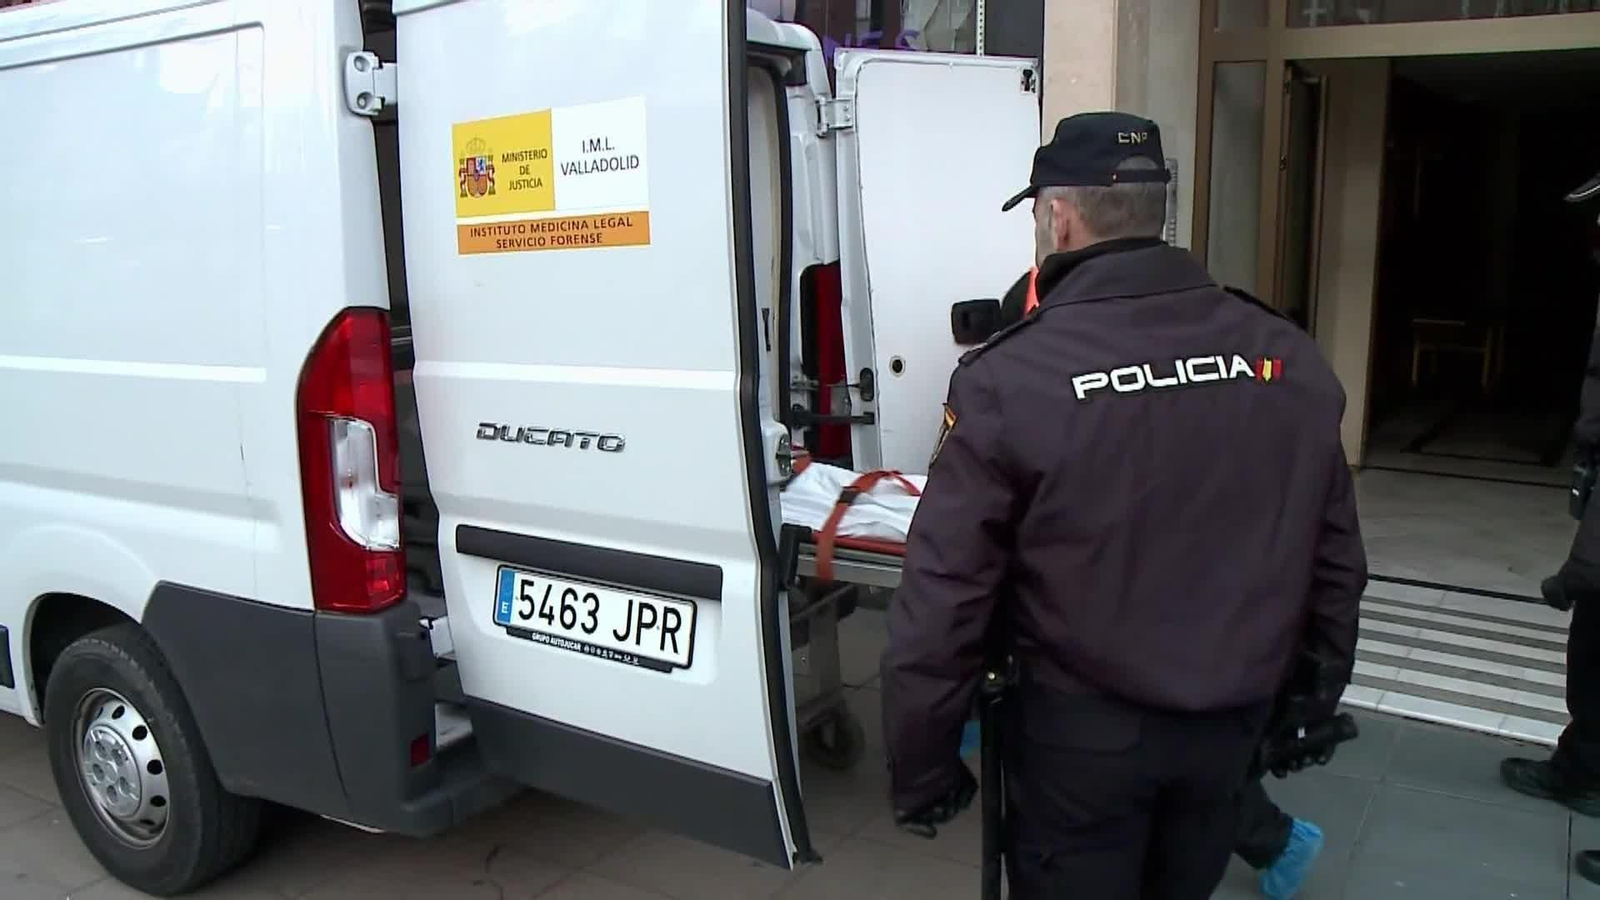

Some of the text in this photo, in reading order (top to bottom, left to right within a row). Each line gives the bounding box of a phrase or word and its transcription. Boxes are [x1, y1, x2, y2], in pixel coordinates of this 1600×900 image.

[582, 136, 615, 154] I.M.L.
[501, 148, 548, 163] MINISTERIO
[519, 165, 530, 176] DE
[560, 154, 640, 176] VALLADOLID
[509, 178, 543, 191] JUSTICIA
[470, 216, 633, 238] INSTITUTO MEDICINA LEGAL
[496, 232, 603, 249] SERVICIO FORENSE
[1071, 354, 1256, 400] POLICIA
[476, 422, 626, 453] DUCATO
[501, 601, 509, 614] E
[518, 578, 682, 655] 5463 JPR
[531, 632, 550, 644] GRUPO
